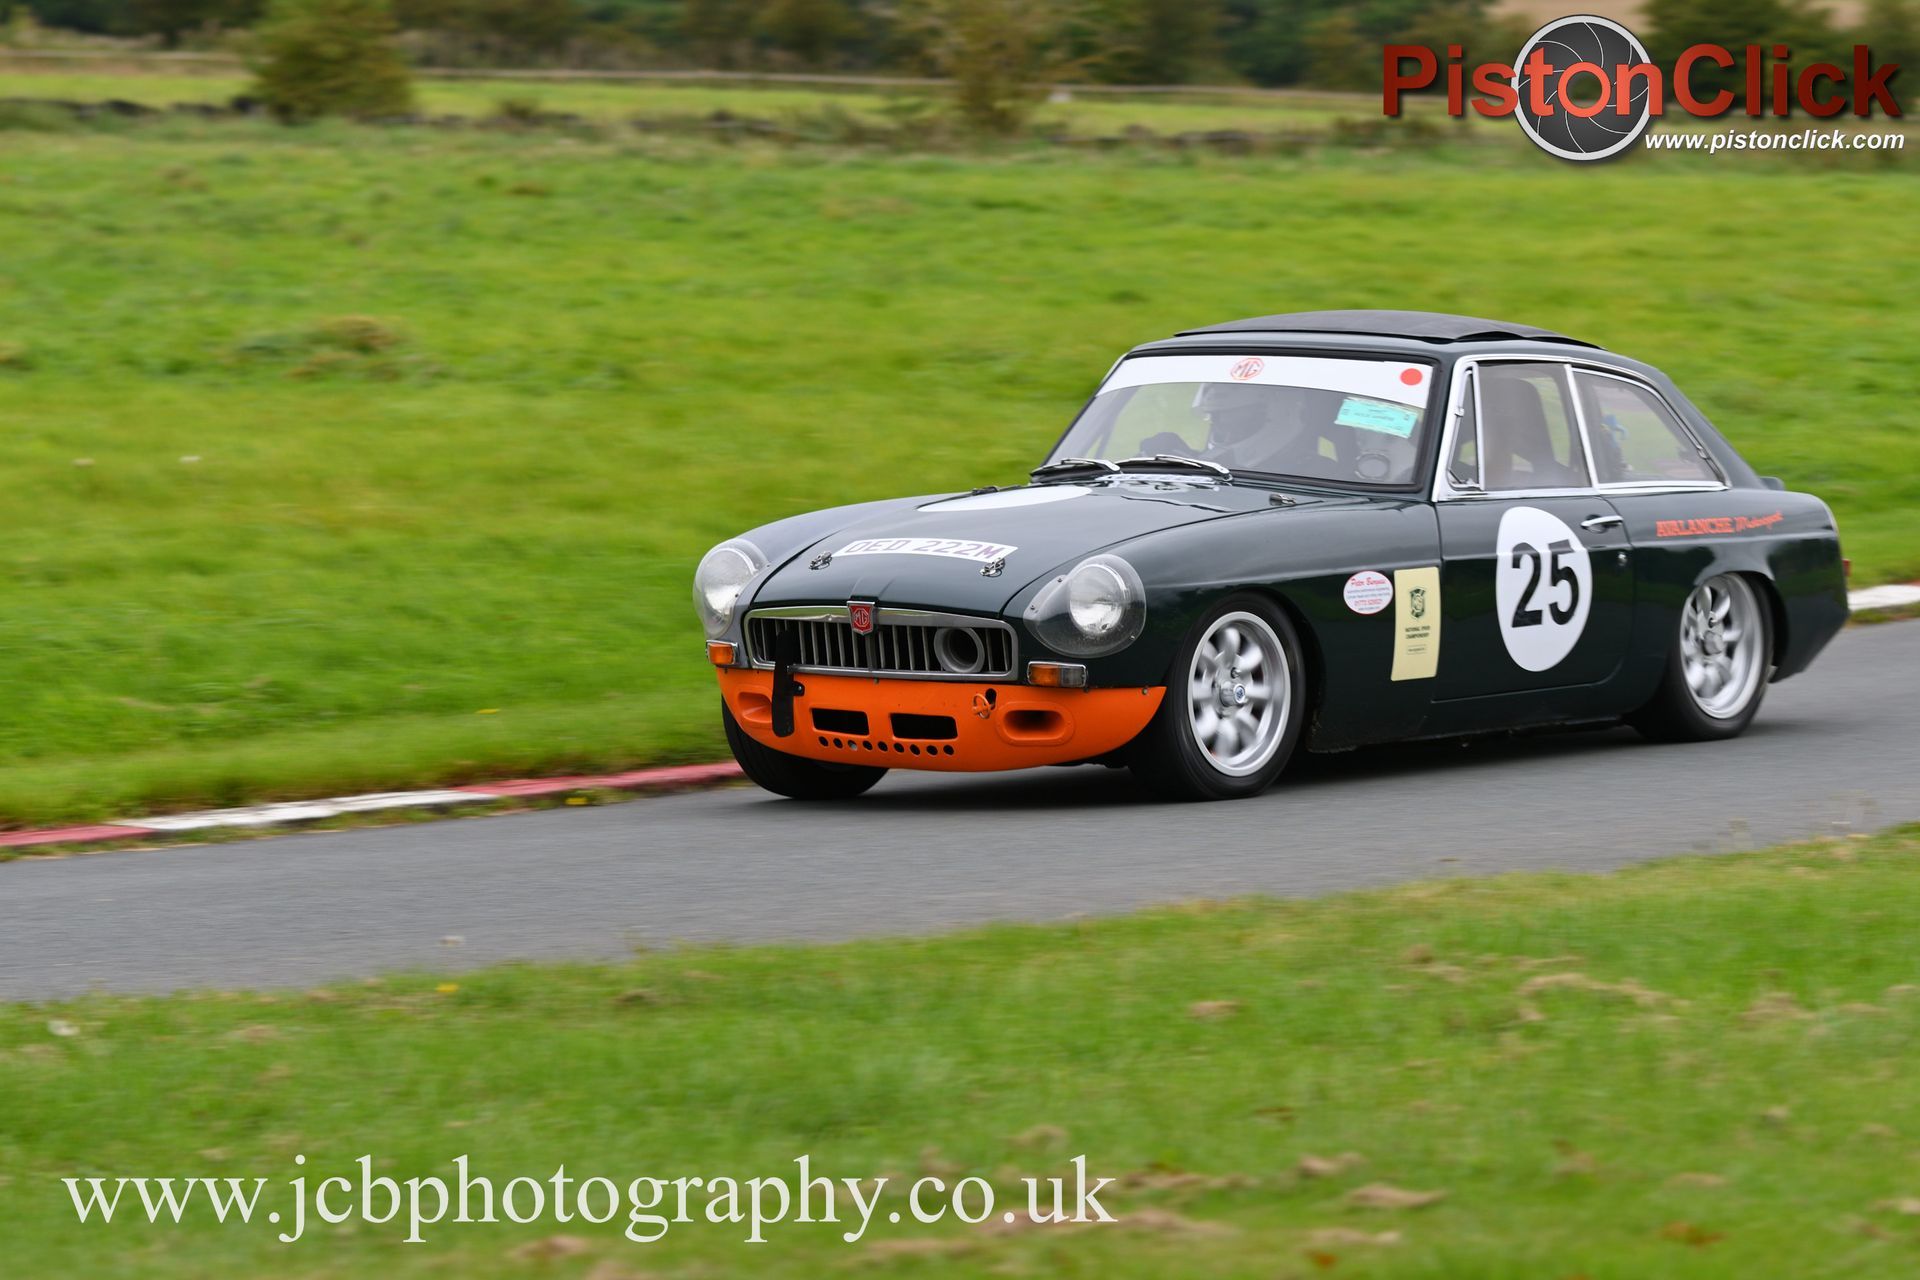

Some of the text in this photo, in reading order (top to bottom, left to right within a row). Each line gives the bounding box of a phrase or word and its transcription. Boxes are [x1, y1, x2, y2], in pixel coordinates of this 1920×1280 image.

[1233, 360, 1261, 379] MG
[914, 541, 1004, 559] 222M
[1511, 539, 1580, 628] 25
[854, 611, 869, 626] MG
